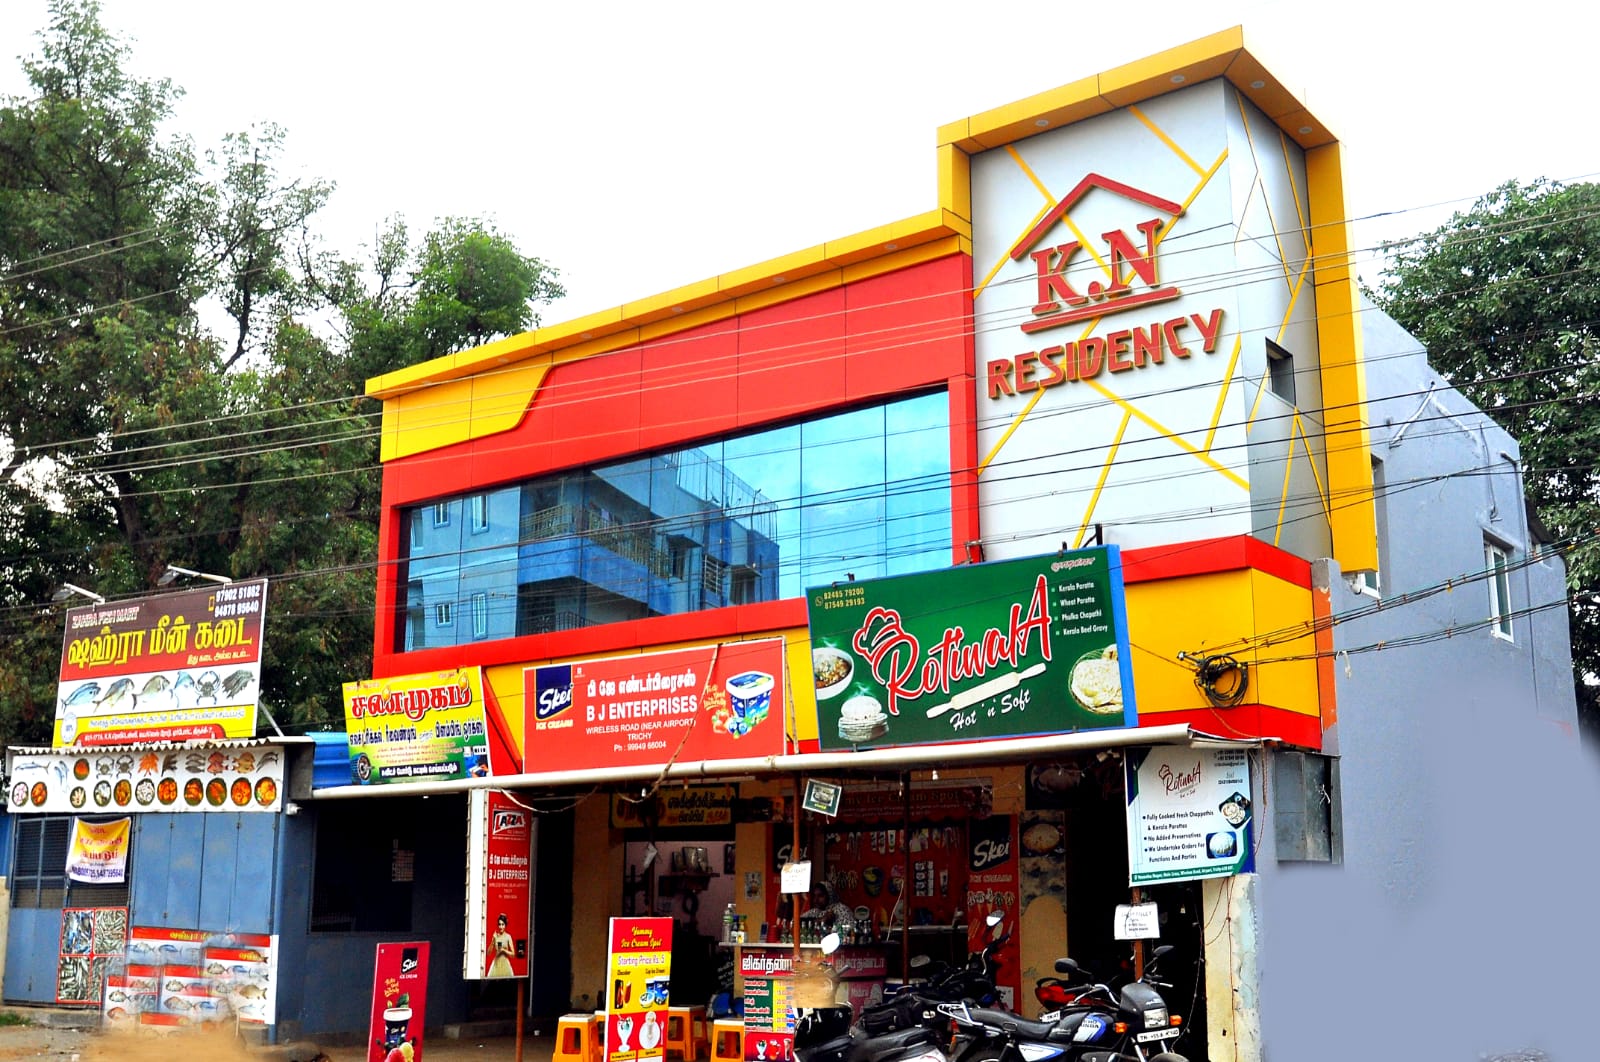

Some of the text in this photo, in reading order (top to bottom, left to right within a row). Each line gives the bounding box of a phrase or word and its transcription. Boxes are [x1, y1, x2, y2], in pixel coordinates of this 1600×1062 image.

[1030, 218, 1162, 315] K.N
[987, 308, 1223, 400] RESIDENCY
[1059, 584, 1076, 592] Kerala
[1060, 599, 1076, 607] Wheat
[149, 615, 191, 655] மீன்
[195, 617, 252, 650] கடை
[1063, 624, 1108, 636] Kerala Beef Gravy
[587, 679, 597, 698] பி
[599, 679, 616, 696] ஜே
[539, 684, 572, 716] Skei
[586, 705, 595, 722] B
[596, 704, 605, 721] J
[609, 694, 698, 720] ENTERPRISES
[950, 712, 977, 731] Hot
[1001, 688, 1031, 714] Soft
[586, 718, 697, 735] WIRELESS ROAD (NEAR AIRPORT)
[627, 732, 653, 742] TRICHY
[1158, 812, 1176, 820] Cooked
[1156, 844, 1181, 852] Undertake
[1149, 855, 1171, 863] Functions
[1181, 853, 1197, 861] Parties
[488, 869, 493, 879] B
[497, 868, 528, 880] ENTERPRISES
[618, 955, 638, 967] Starting
